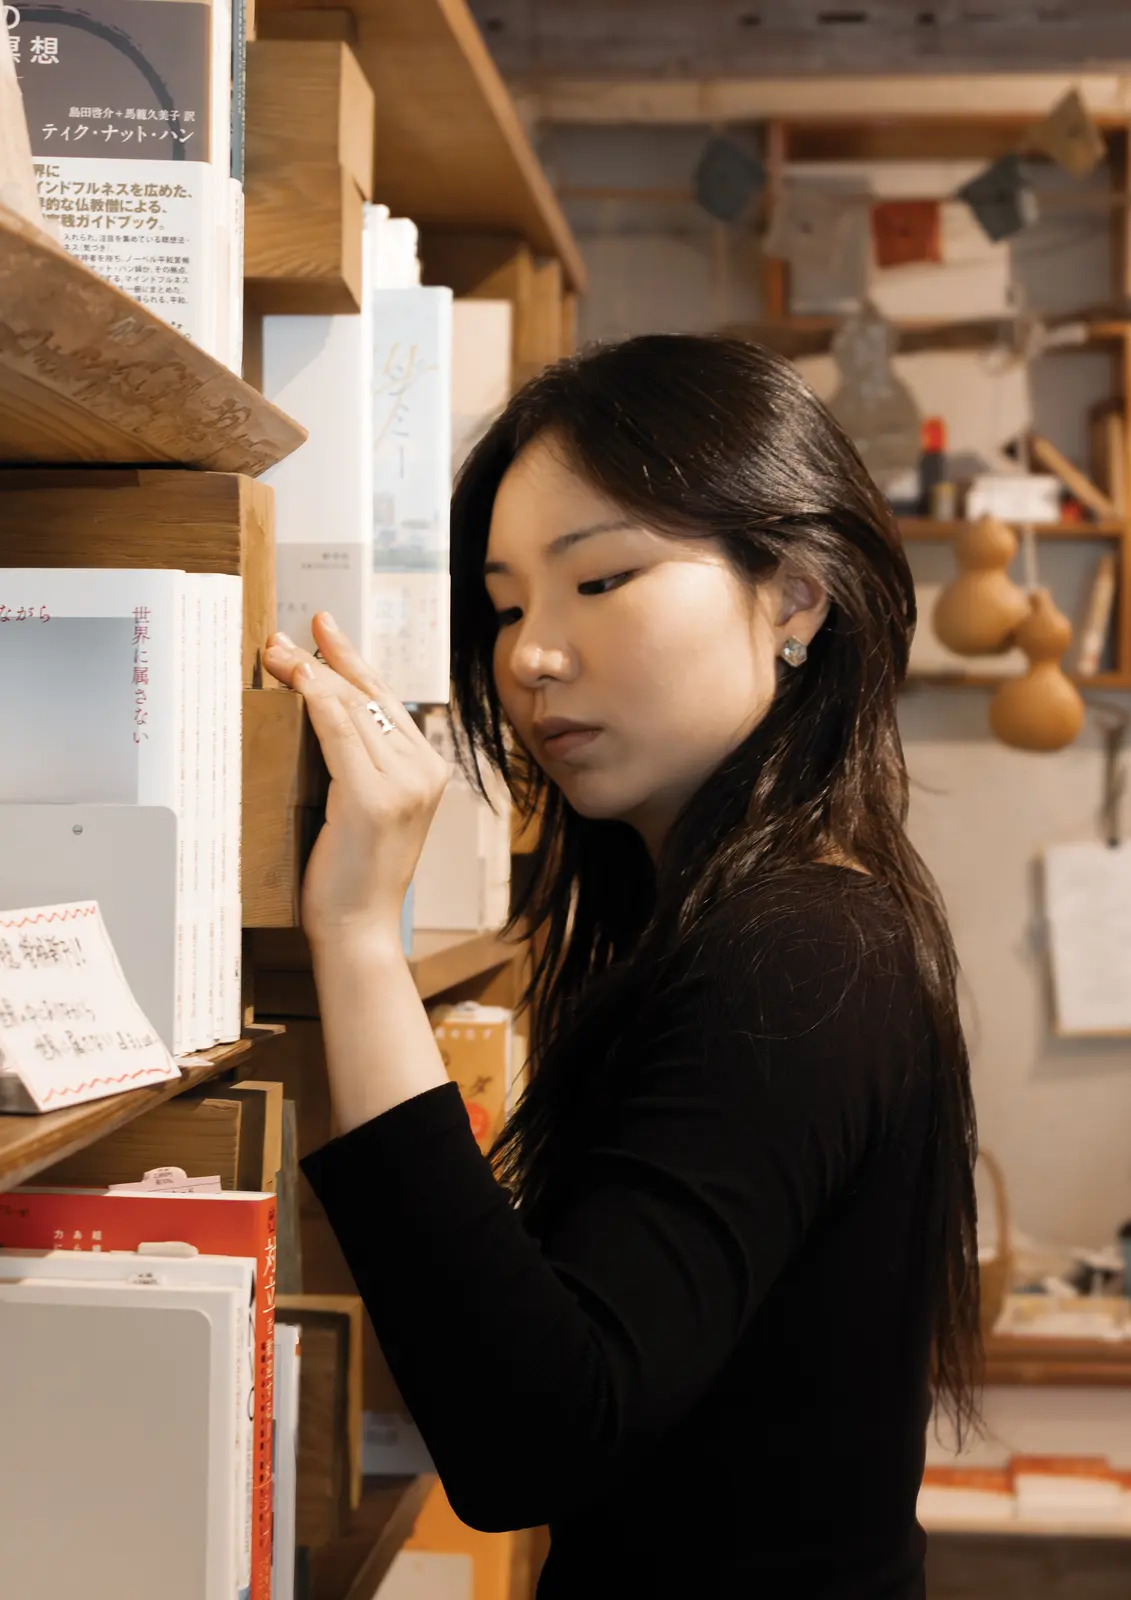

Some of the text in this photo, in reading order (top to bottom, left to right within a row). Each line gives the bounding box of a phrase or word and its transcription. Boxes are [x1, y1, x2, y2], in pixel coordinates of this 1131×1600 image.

[42, 123, 195, 143] ティク・ナット・ハン
[132, 606, 151, 743] 世界に属さない
